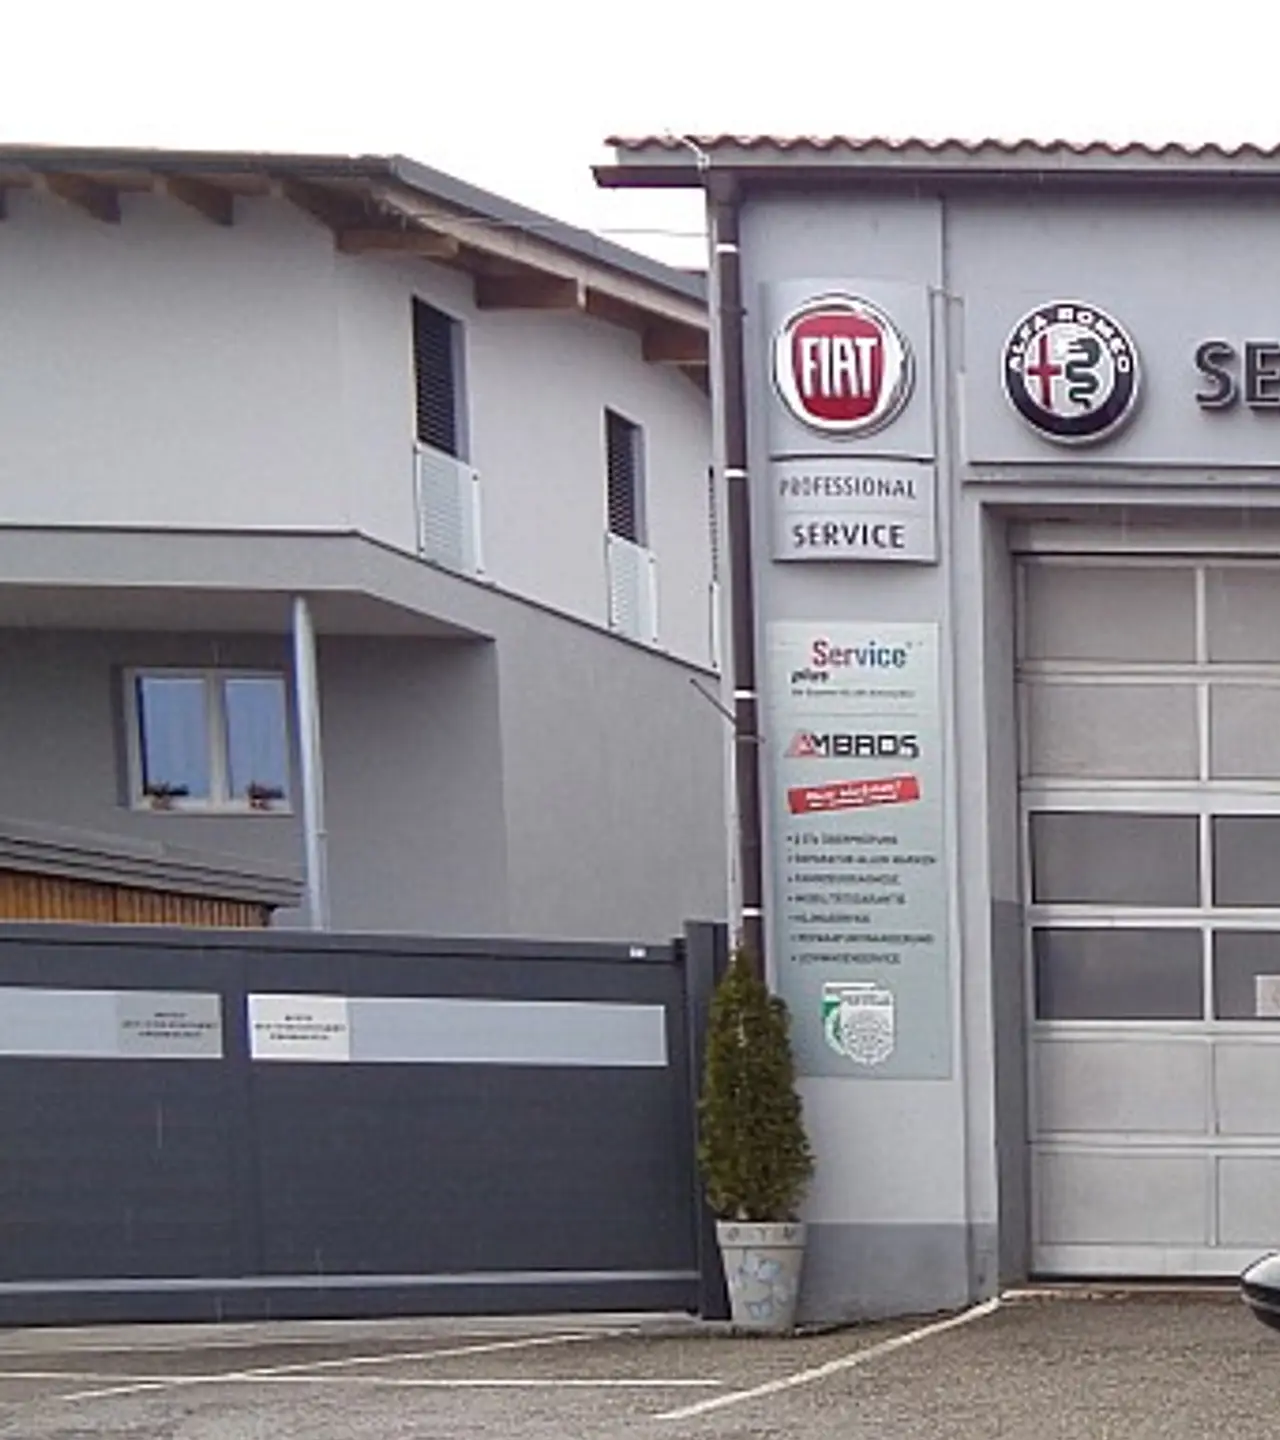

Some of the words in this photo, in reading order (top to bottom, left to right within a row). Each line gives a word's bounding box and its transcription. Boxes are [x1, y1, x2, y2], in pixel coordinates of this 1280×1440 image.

[800, 336, 879, 398] FIAT
[779, 477, 917, 500] PROFESSIONAL
[793, 522, 906, 549] SERVICE
[812, 639, 908, 669] Service
[784, 730, 920, 759] AMBROS
